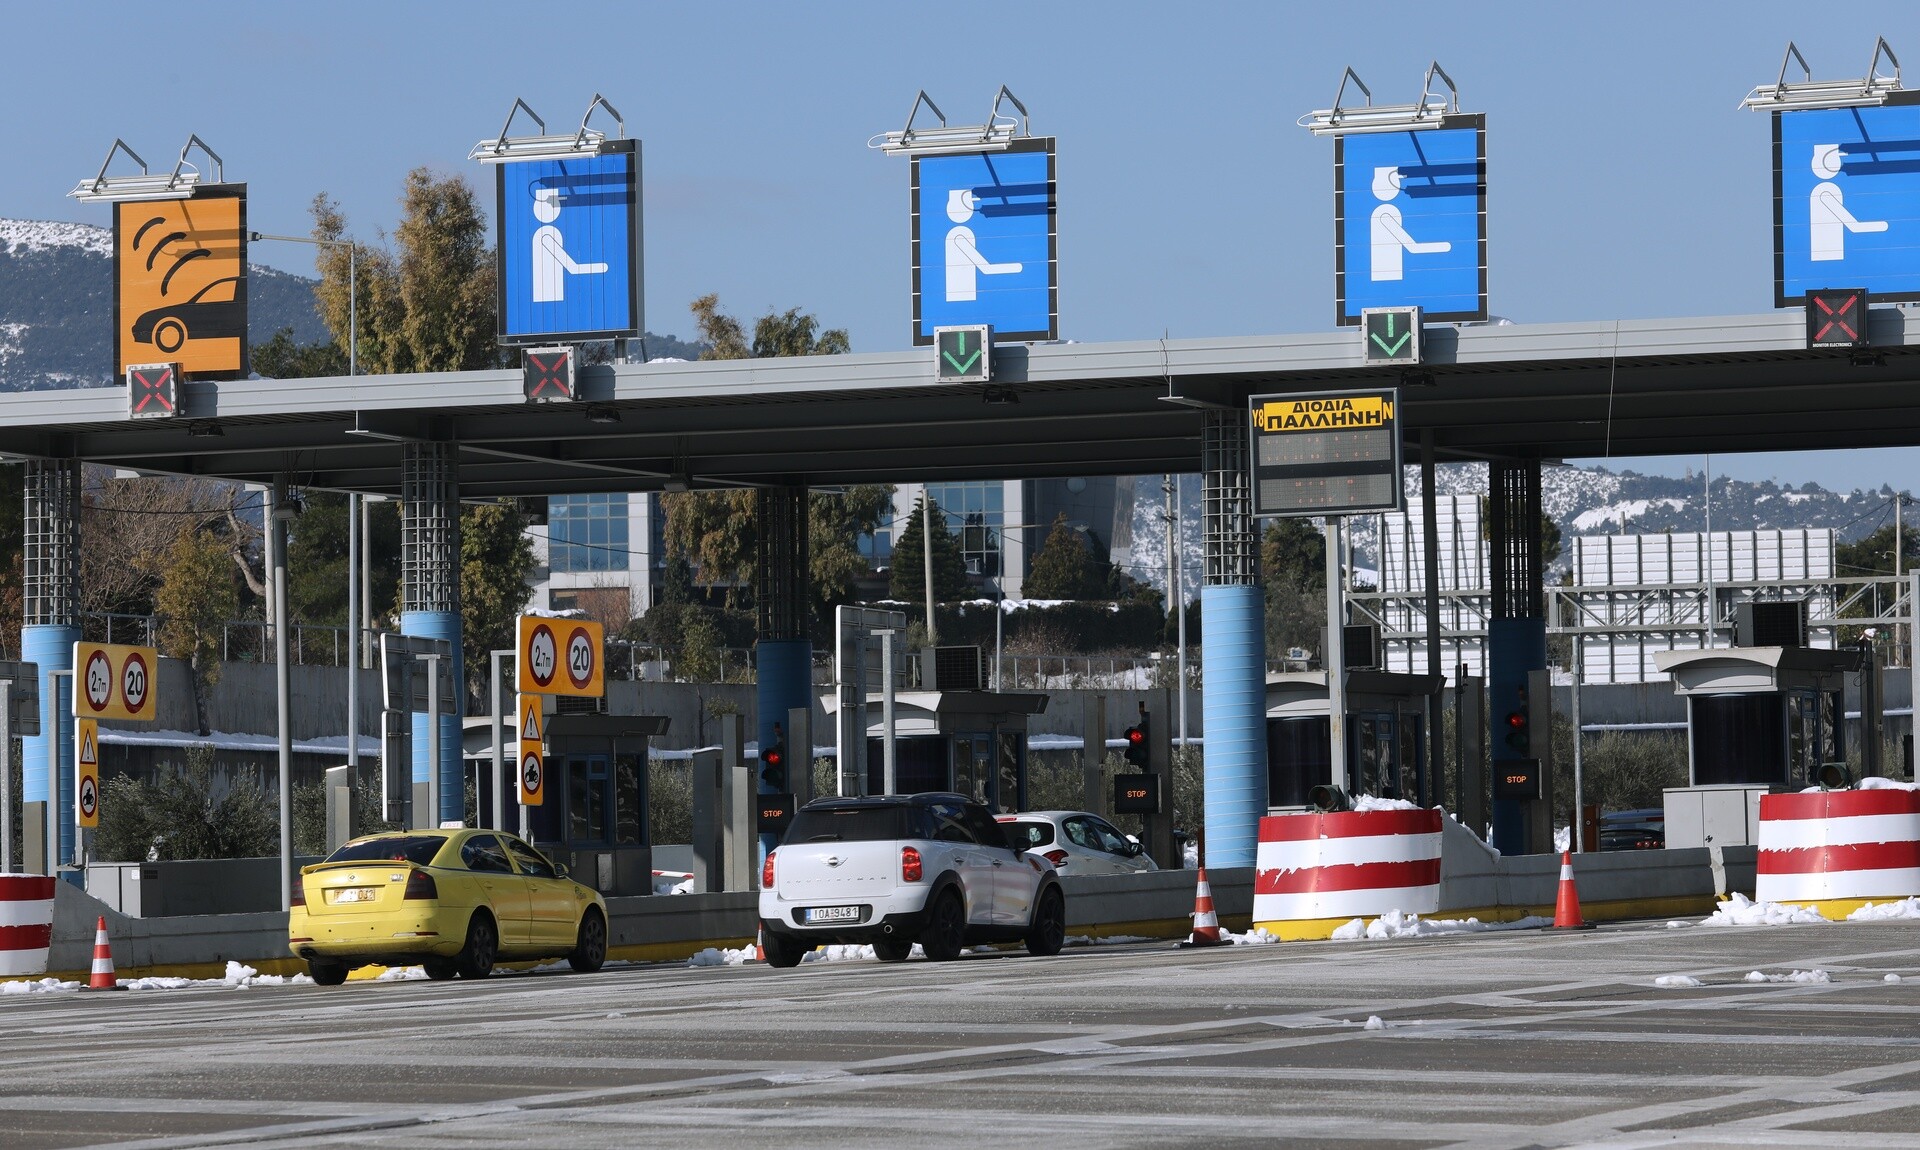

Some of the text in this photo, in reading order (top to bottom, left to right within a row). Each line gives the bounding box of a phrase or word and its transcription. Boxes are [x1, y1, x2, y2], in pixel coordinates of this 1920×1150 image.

[1292, 400, 1353, 413] ΔΙΟΔΙΑ
[1267, 410, 1381, 429] ΠΑΛΛΗΝΗ
[573, 645, 589, 671] 20
[127, 670, 143, 696] 20
[1506, 775, 1527, 784] STOP
[1126, 790, 1147, 798] STOP
[763, 810, 783, 818] STOP
